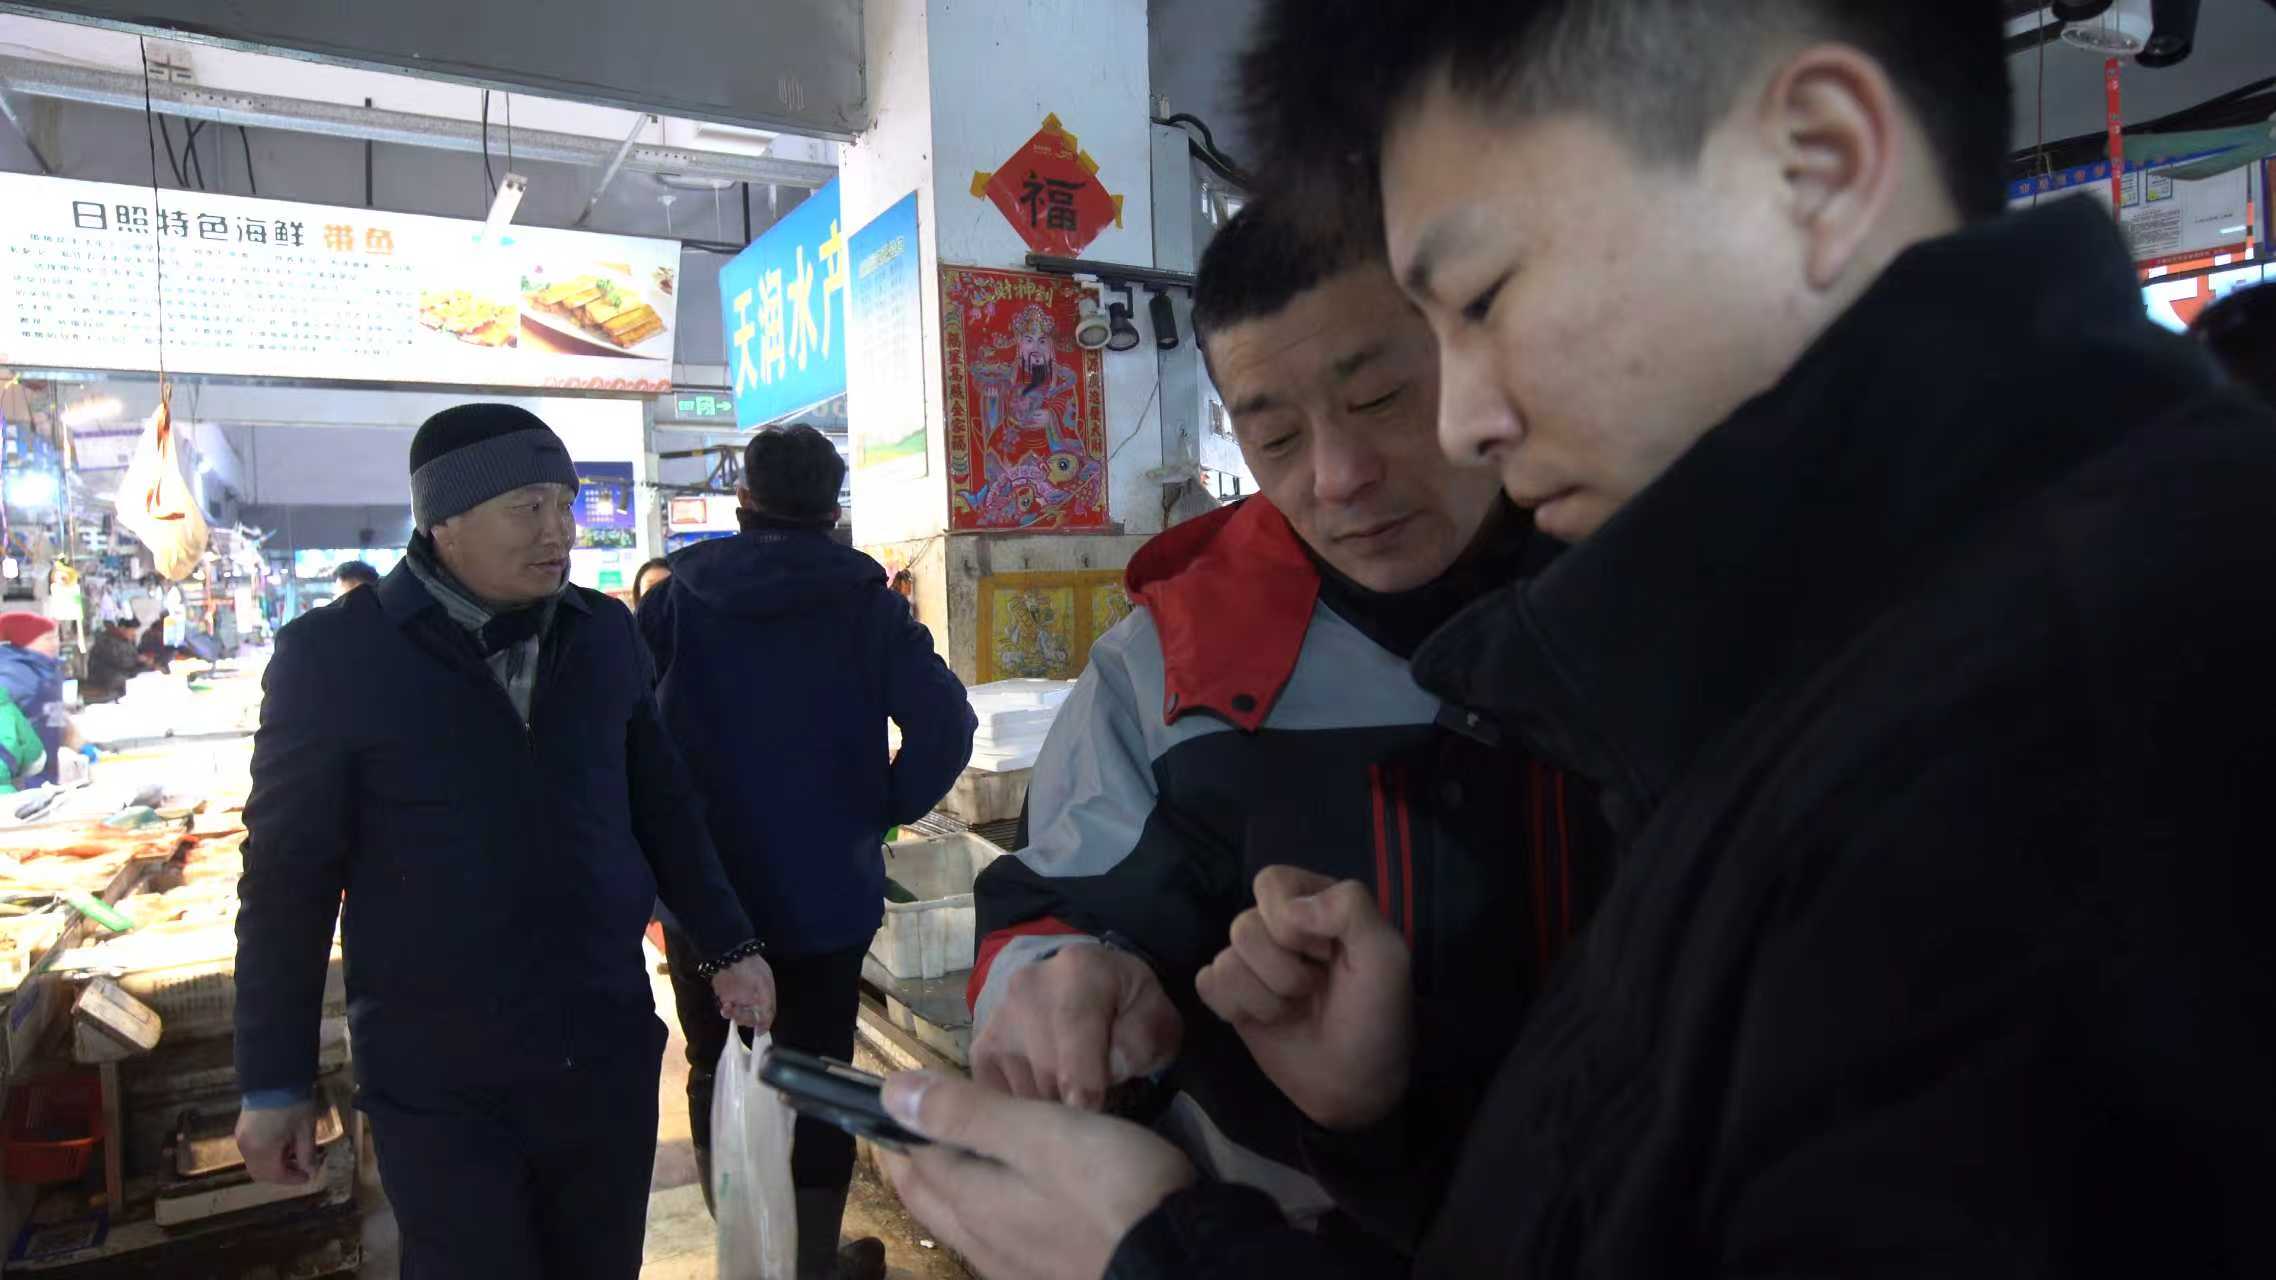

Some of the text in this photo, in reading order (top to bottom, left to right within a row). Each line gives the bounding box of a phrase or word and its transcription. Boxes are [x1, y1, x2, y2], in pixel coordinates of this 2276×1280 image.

[72, 200, 395, 256] 日照特色海鲜 带鱼
[1020, 169, 1086, 232] 福
[732, 216, 846, 397] 天润水产
